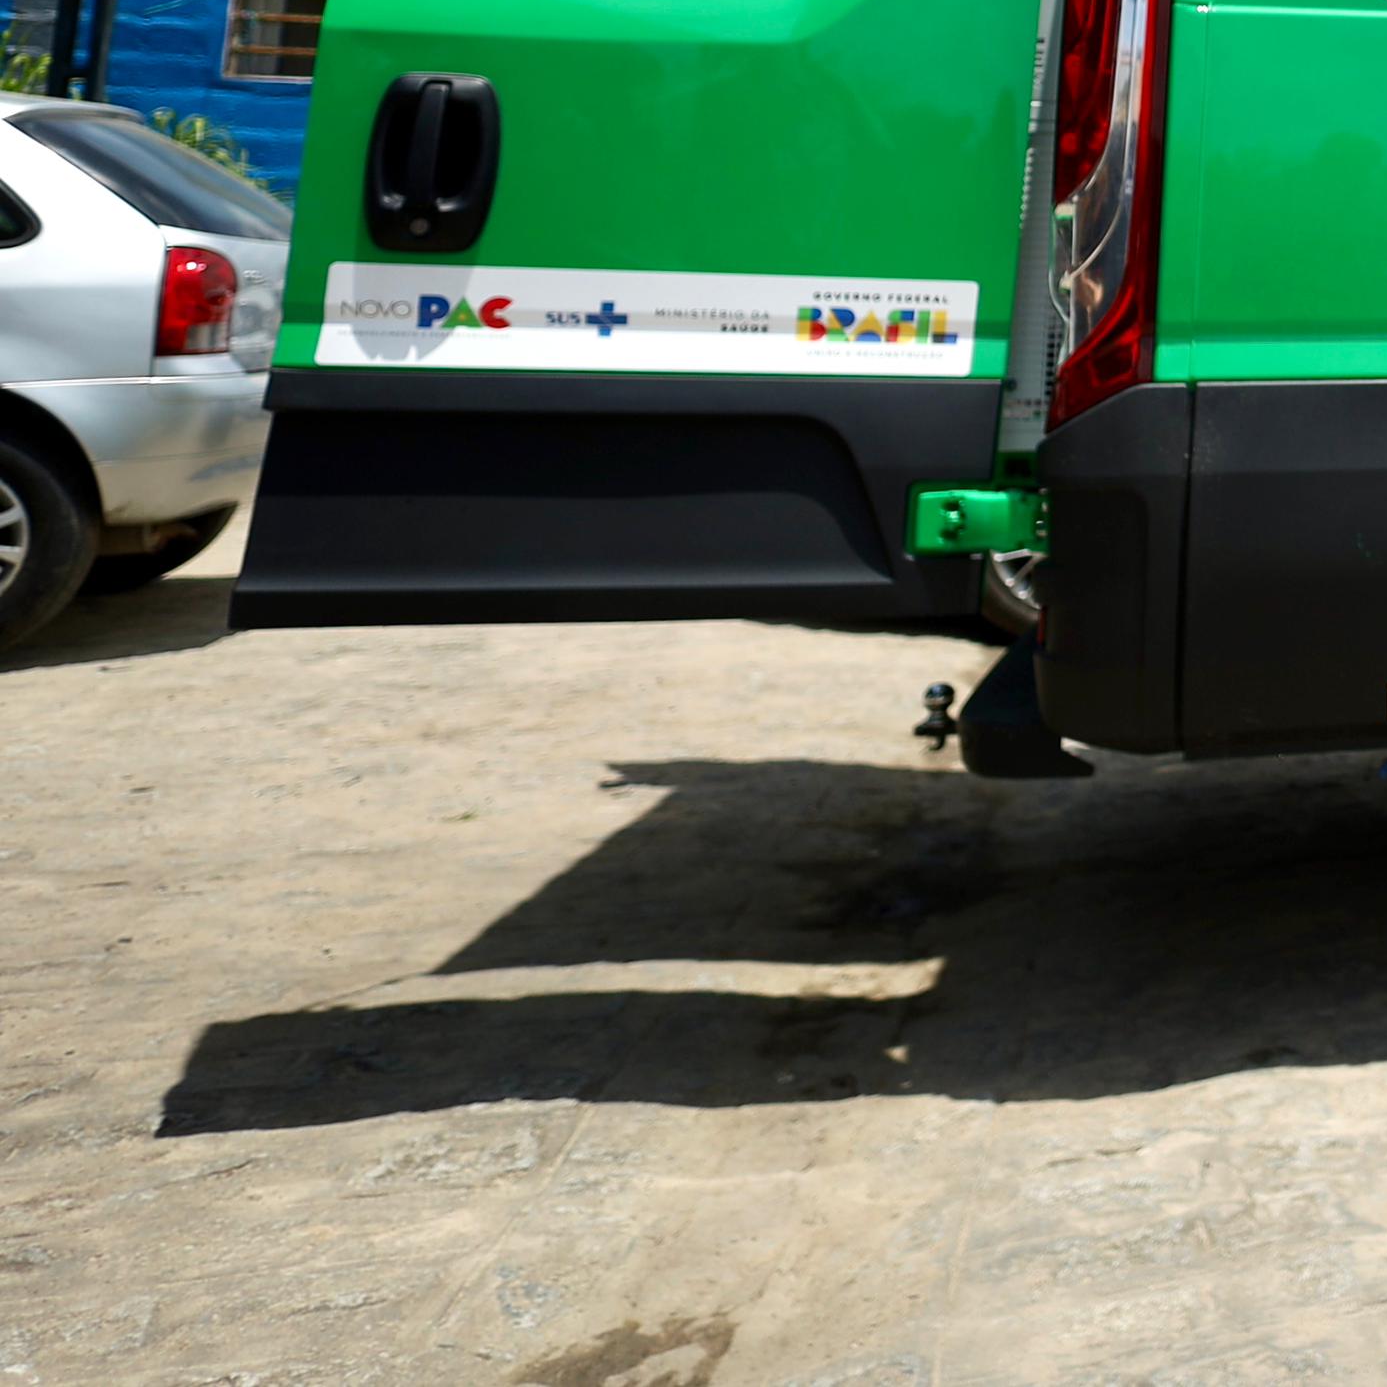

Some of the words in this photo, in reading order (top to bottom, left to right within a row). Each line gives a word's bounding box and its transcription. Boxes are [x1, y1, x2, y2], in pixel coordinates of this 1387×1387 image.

[340, 299, 412, 319] NOVO
[416, 295, 513, 330] PAC
[545, 312, 581, 325] SUS
[795, 306, 959, 345] BRASIL
